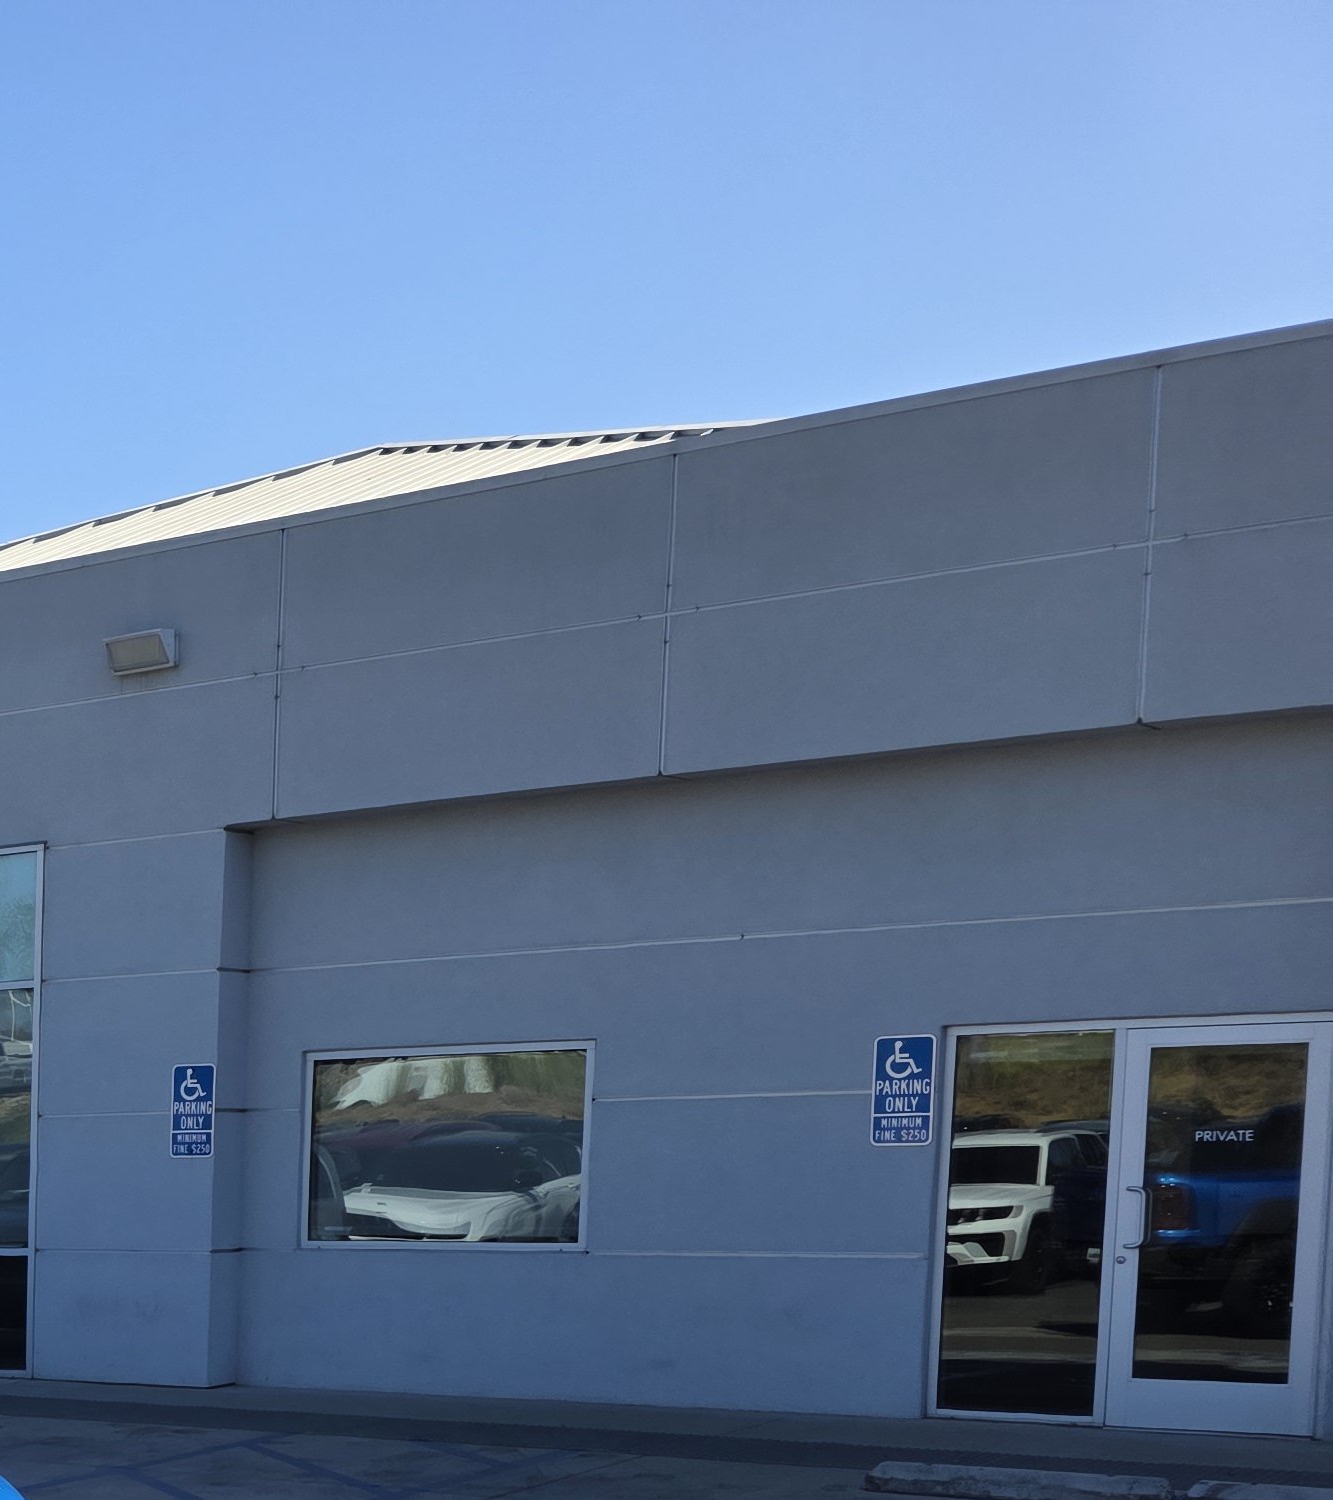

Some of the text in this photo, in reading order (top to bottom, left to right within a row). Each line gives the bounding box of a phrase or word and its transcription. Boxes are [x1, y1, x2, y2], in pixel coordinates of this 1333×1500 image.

[875, 1079, 931, 1096] PARKING
[173, 1101, 213, 1115] PARKING
[885, 1096, 919, 1112] ONLY
[180, 1116, 204, 1129] ONLY
[880, 1117, 923, 1129] MINIMUM
[177, 1133, 207, 1143] MINIMUM
[875, 1129, 927, 1141] FINE $250
[1194, 1130, 1255, 1142] PRIVATE
[173, 1144, 211, 1154] FINE $250
